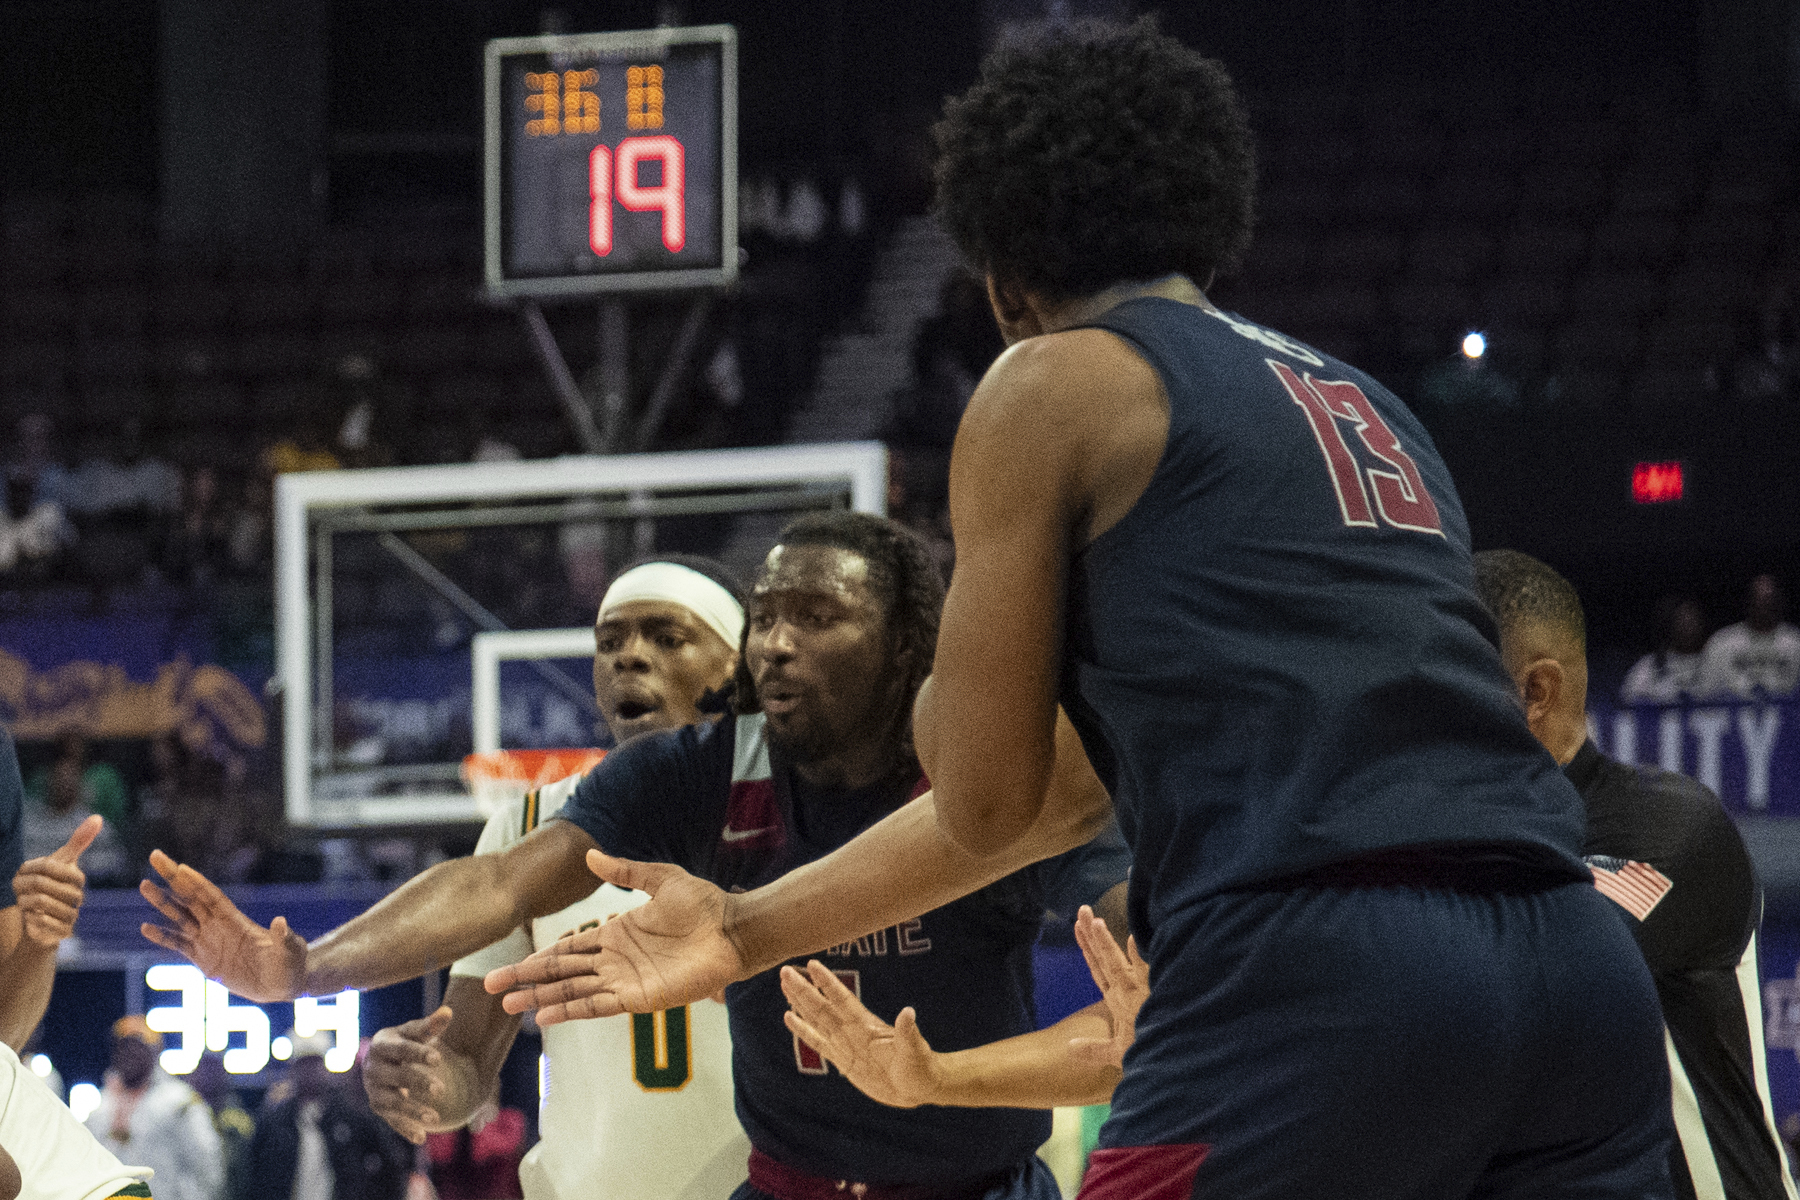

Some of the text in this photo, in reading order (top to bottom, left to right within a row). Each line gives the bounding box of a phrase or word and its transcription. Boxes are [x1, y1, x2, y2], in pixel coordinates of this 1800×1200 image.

[524, 68, 600, 138] 36
[589, 134, 686, 257] 19
[1264, 357, 1446, 540] 13
[145, 964, 360, 1075] 36.9
